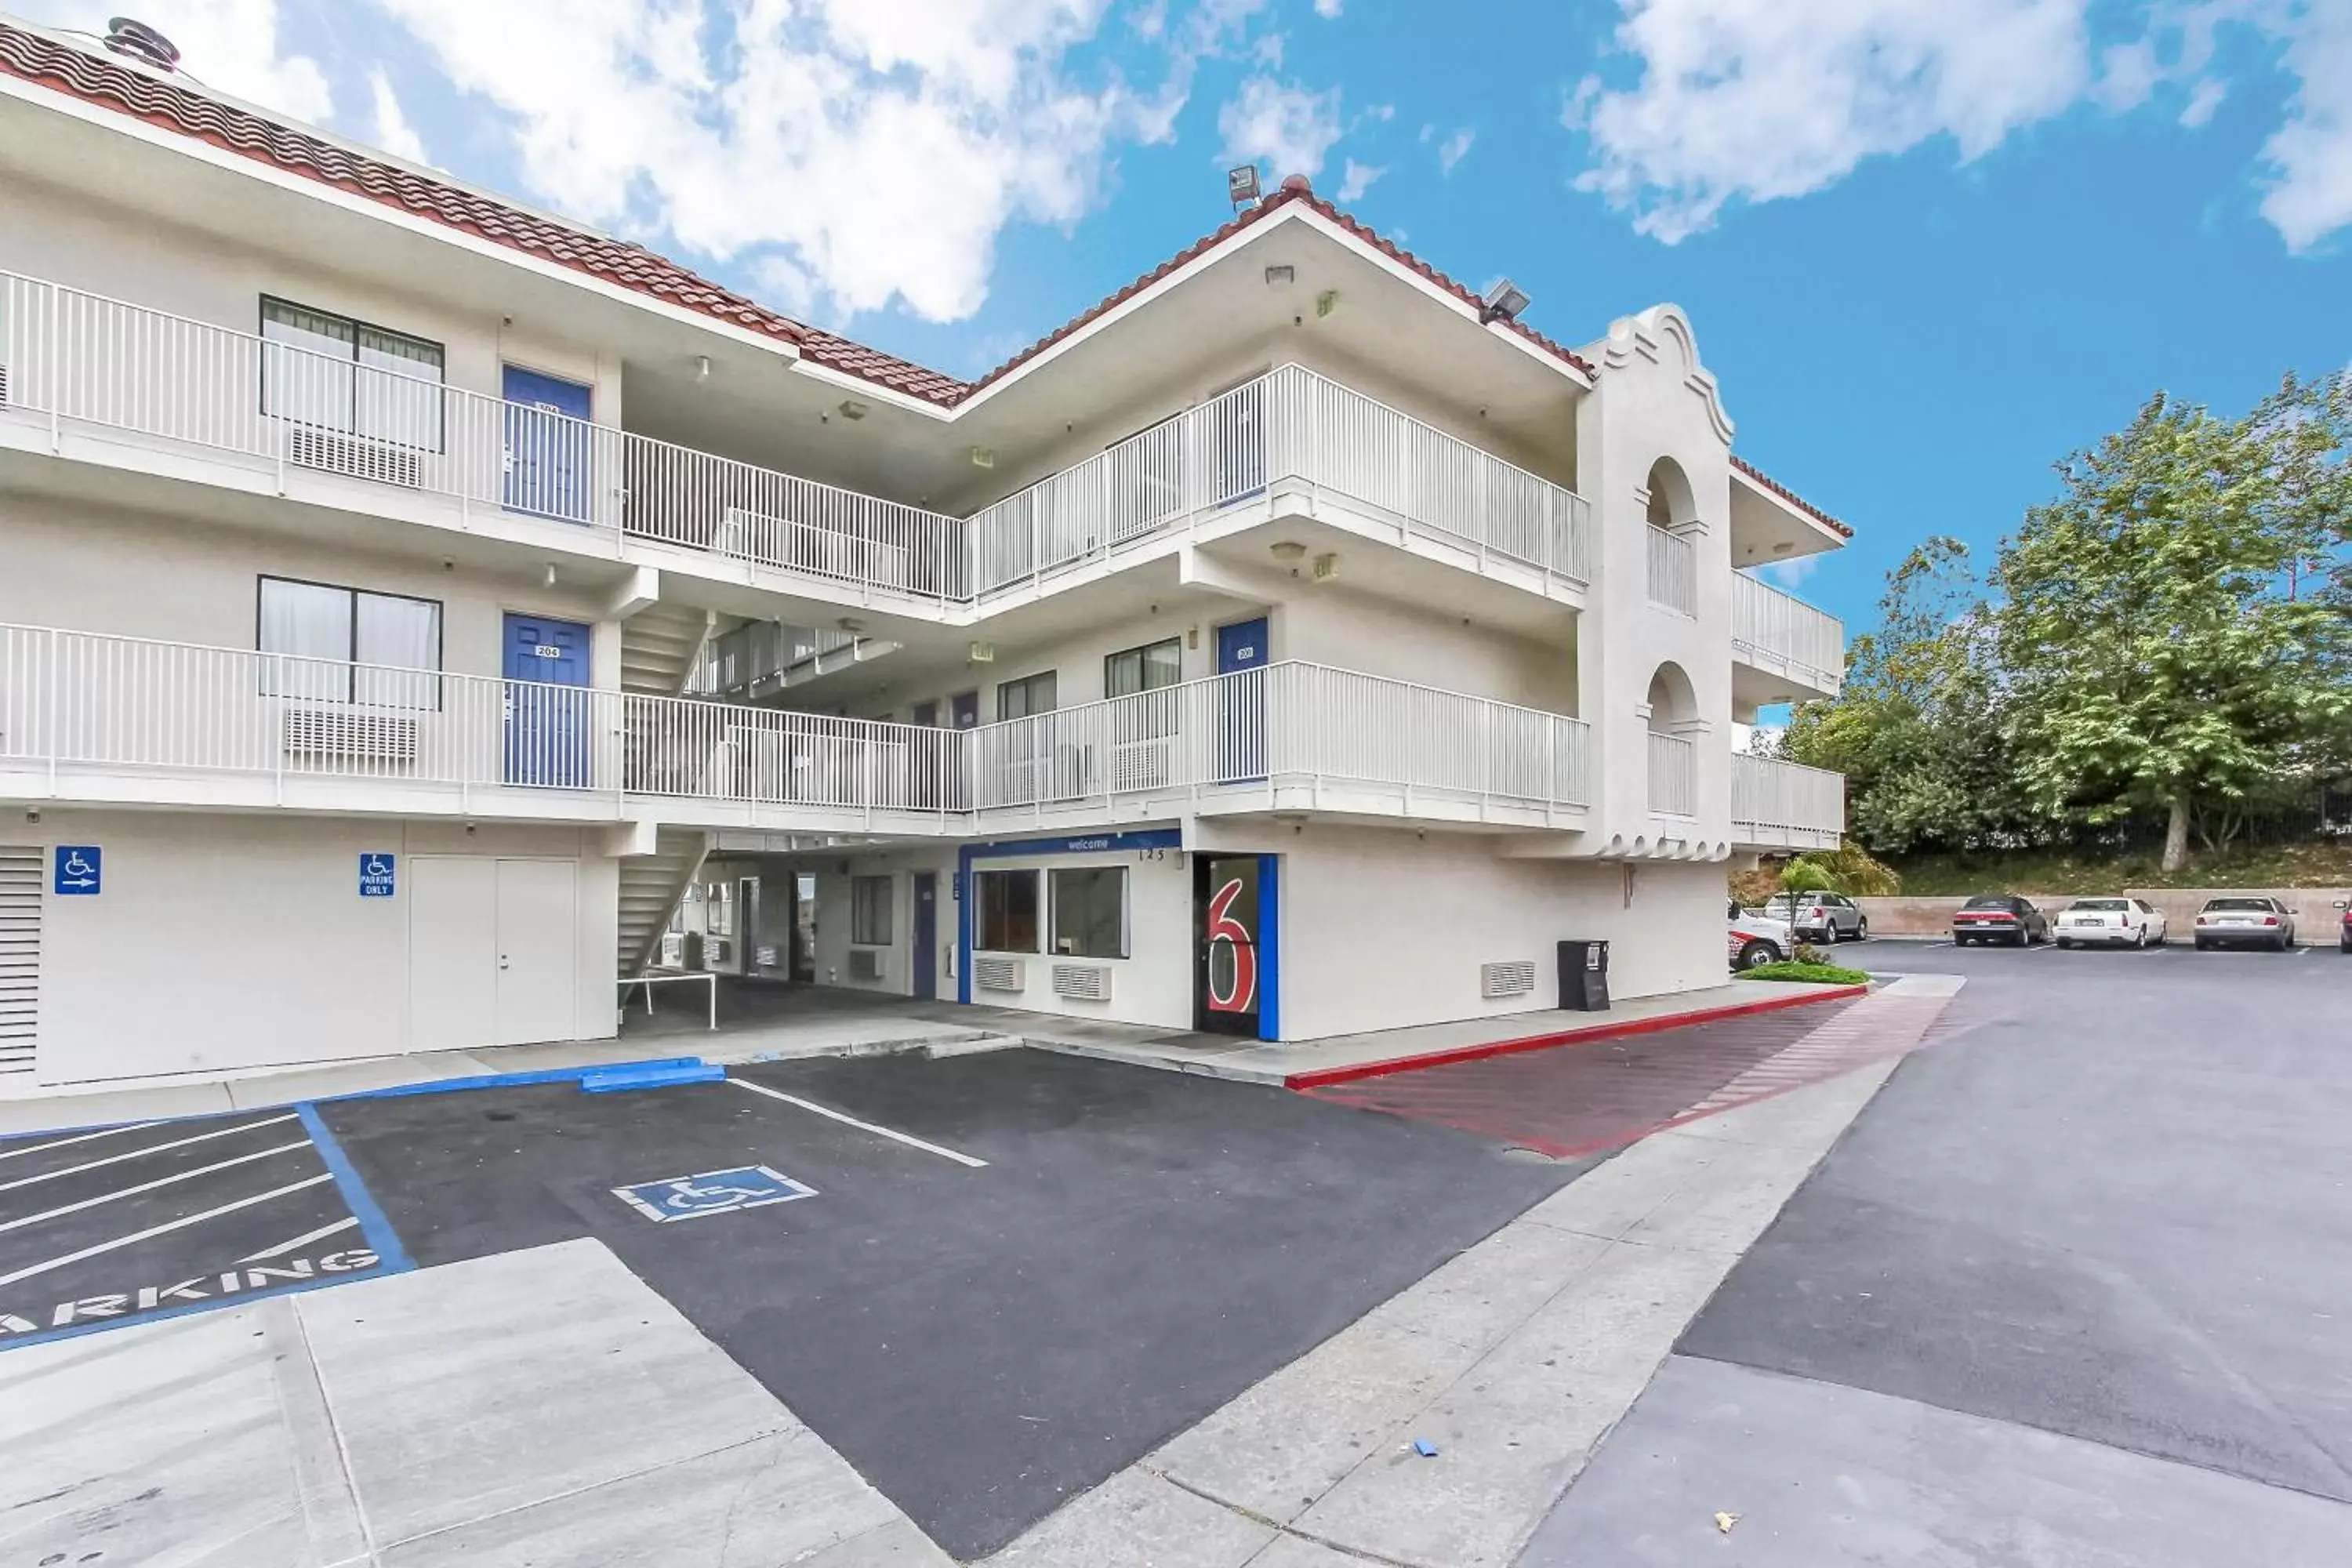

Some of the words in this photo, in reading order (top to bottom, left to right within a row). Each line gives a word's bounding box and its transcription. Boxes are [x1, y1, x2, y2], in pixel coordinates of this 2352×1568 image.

[539, 647, 557, 656] 204
[1068, 838, 1109, 850] welcome
[1138, 845, 1165, 861] 125
[361, 876, 394, 884] PARKING
[366, 885, 387, 894] ONLY
[1209, 878, 1255, 1013] 6
